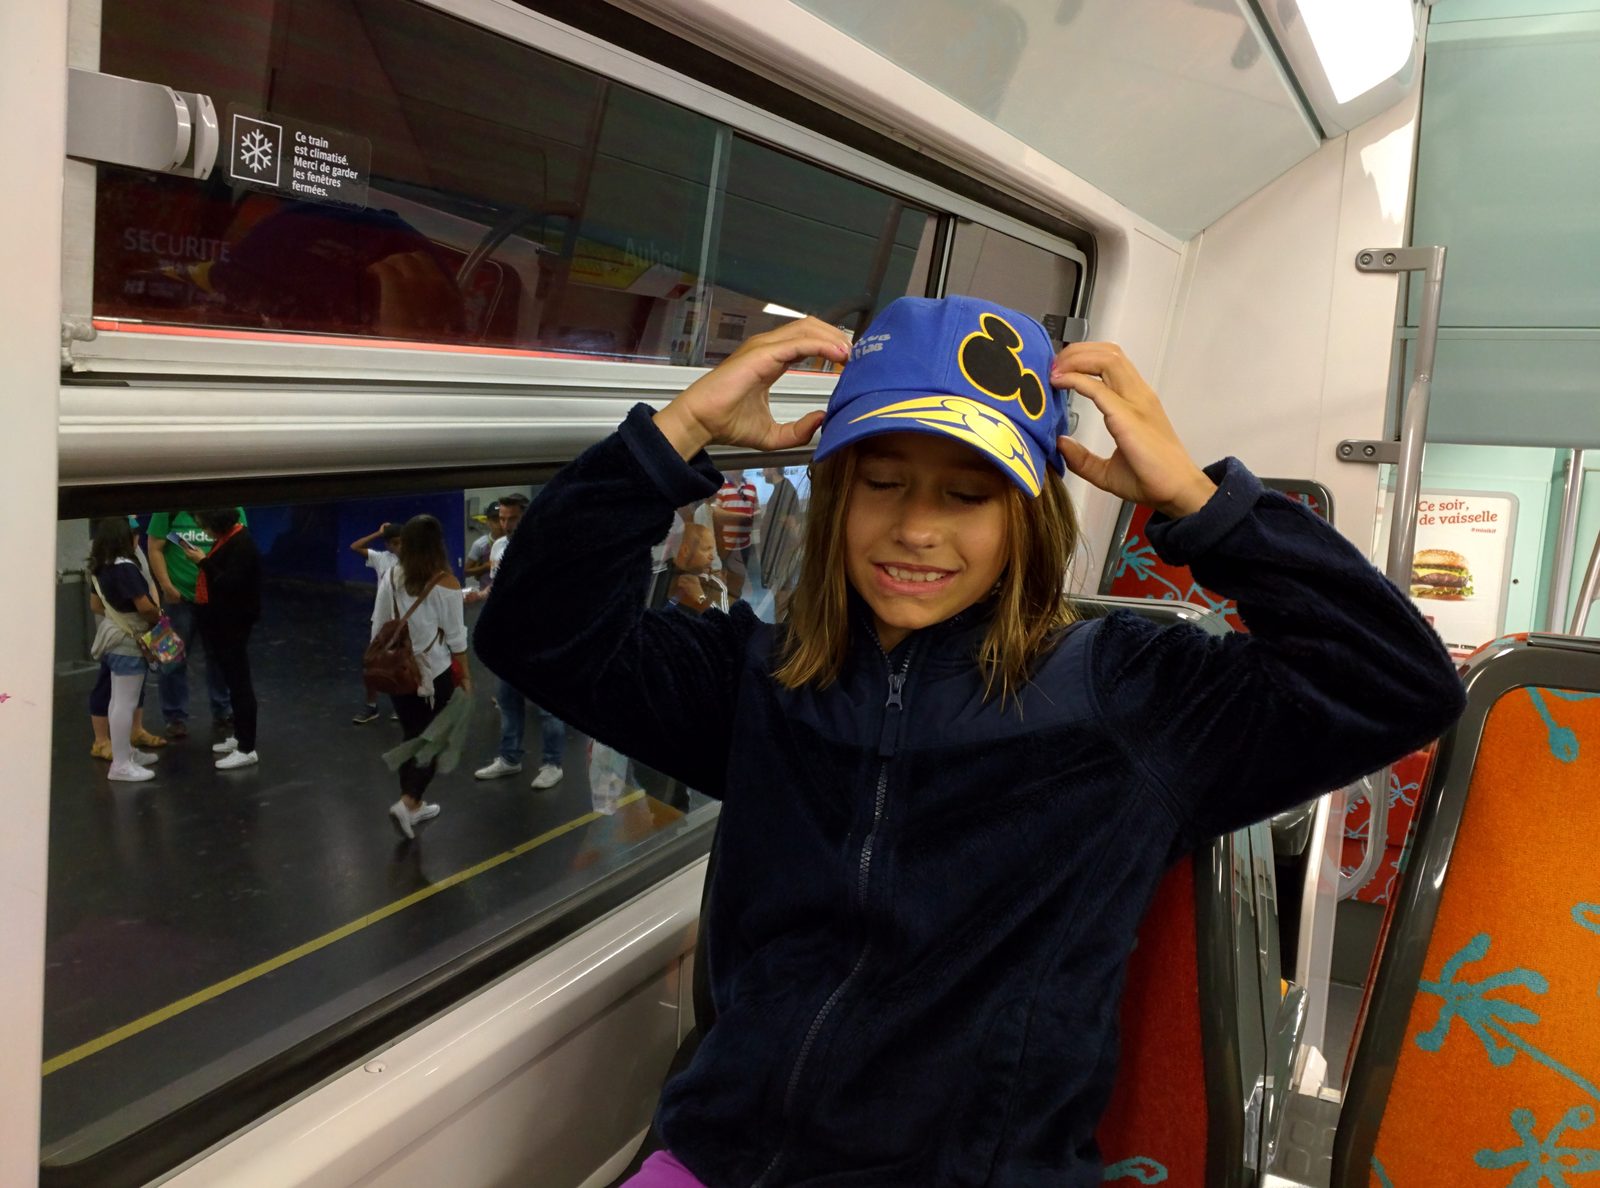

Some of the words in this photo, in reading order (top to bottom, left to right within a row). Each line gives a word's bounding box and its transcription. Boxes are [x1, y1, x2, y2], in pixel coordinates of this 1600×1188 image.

[295, 131, 306, 143] Ce
[308, 135, 329, 148] train
[294, 145, 308, 156] est
[309, 148, 349, 165] climatisé.
[294, 156, 318, 170] Merci
[319, 162, 331, 174] de
[332, 167, 358, 179] garder
[292, 168, 305, 180] les
[307, 171, 341, 187] fenêtres
[292, 181, 328, 196] fermées.
[1417, 501, 1435, 511] Ce
[1439, 499, 1470, 512] soir,
[1419, 514, 1436, 526] de
[1439, 511, 1498, 525] vaisselle
